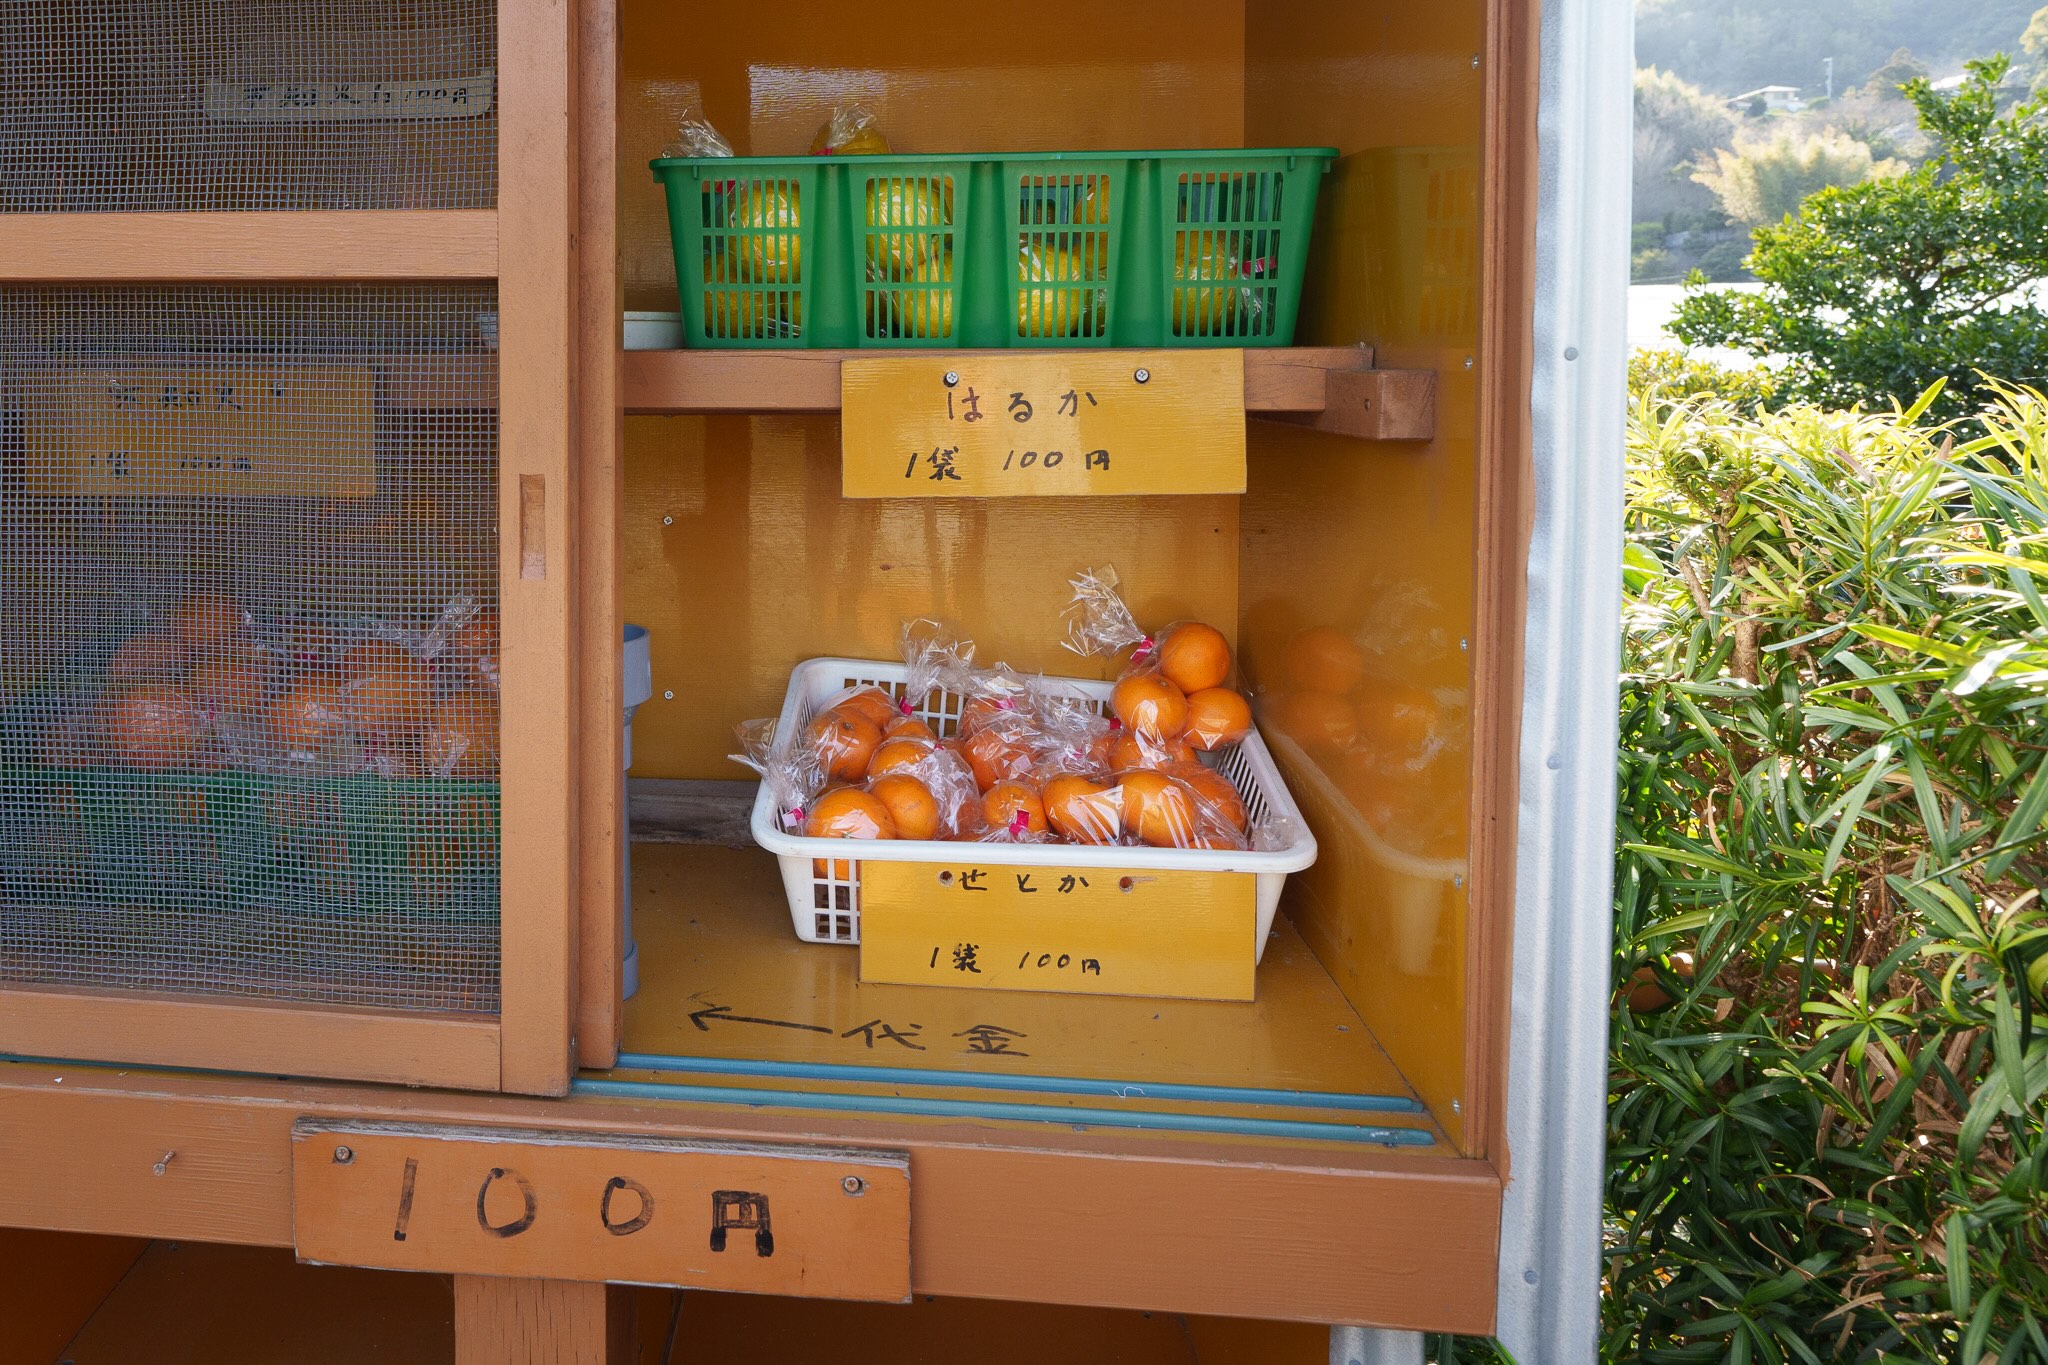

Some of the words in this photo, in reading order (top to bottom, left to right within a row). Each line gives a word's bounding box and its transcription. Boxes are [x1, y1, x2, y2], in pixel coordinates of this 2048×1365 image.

[947, 386, 1098, 424] はるか
[904, 446, 962, 481] 1袋
[1002, 449, 1111, 471] 100円
[958, 868, 1090, 894] せとか
[929, 942, 982, 974] 1袋
[1018, 951, 1101, 976] 100円
[841, 1018, 1030, 1057] 代金
[394, 1156, 775, 1258] 100円
